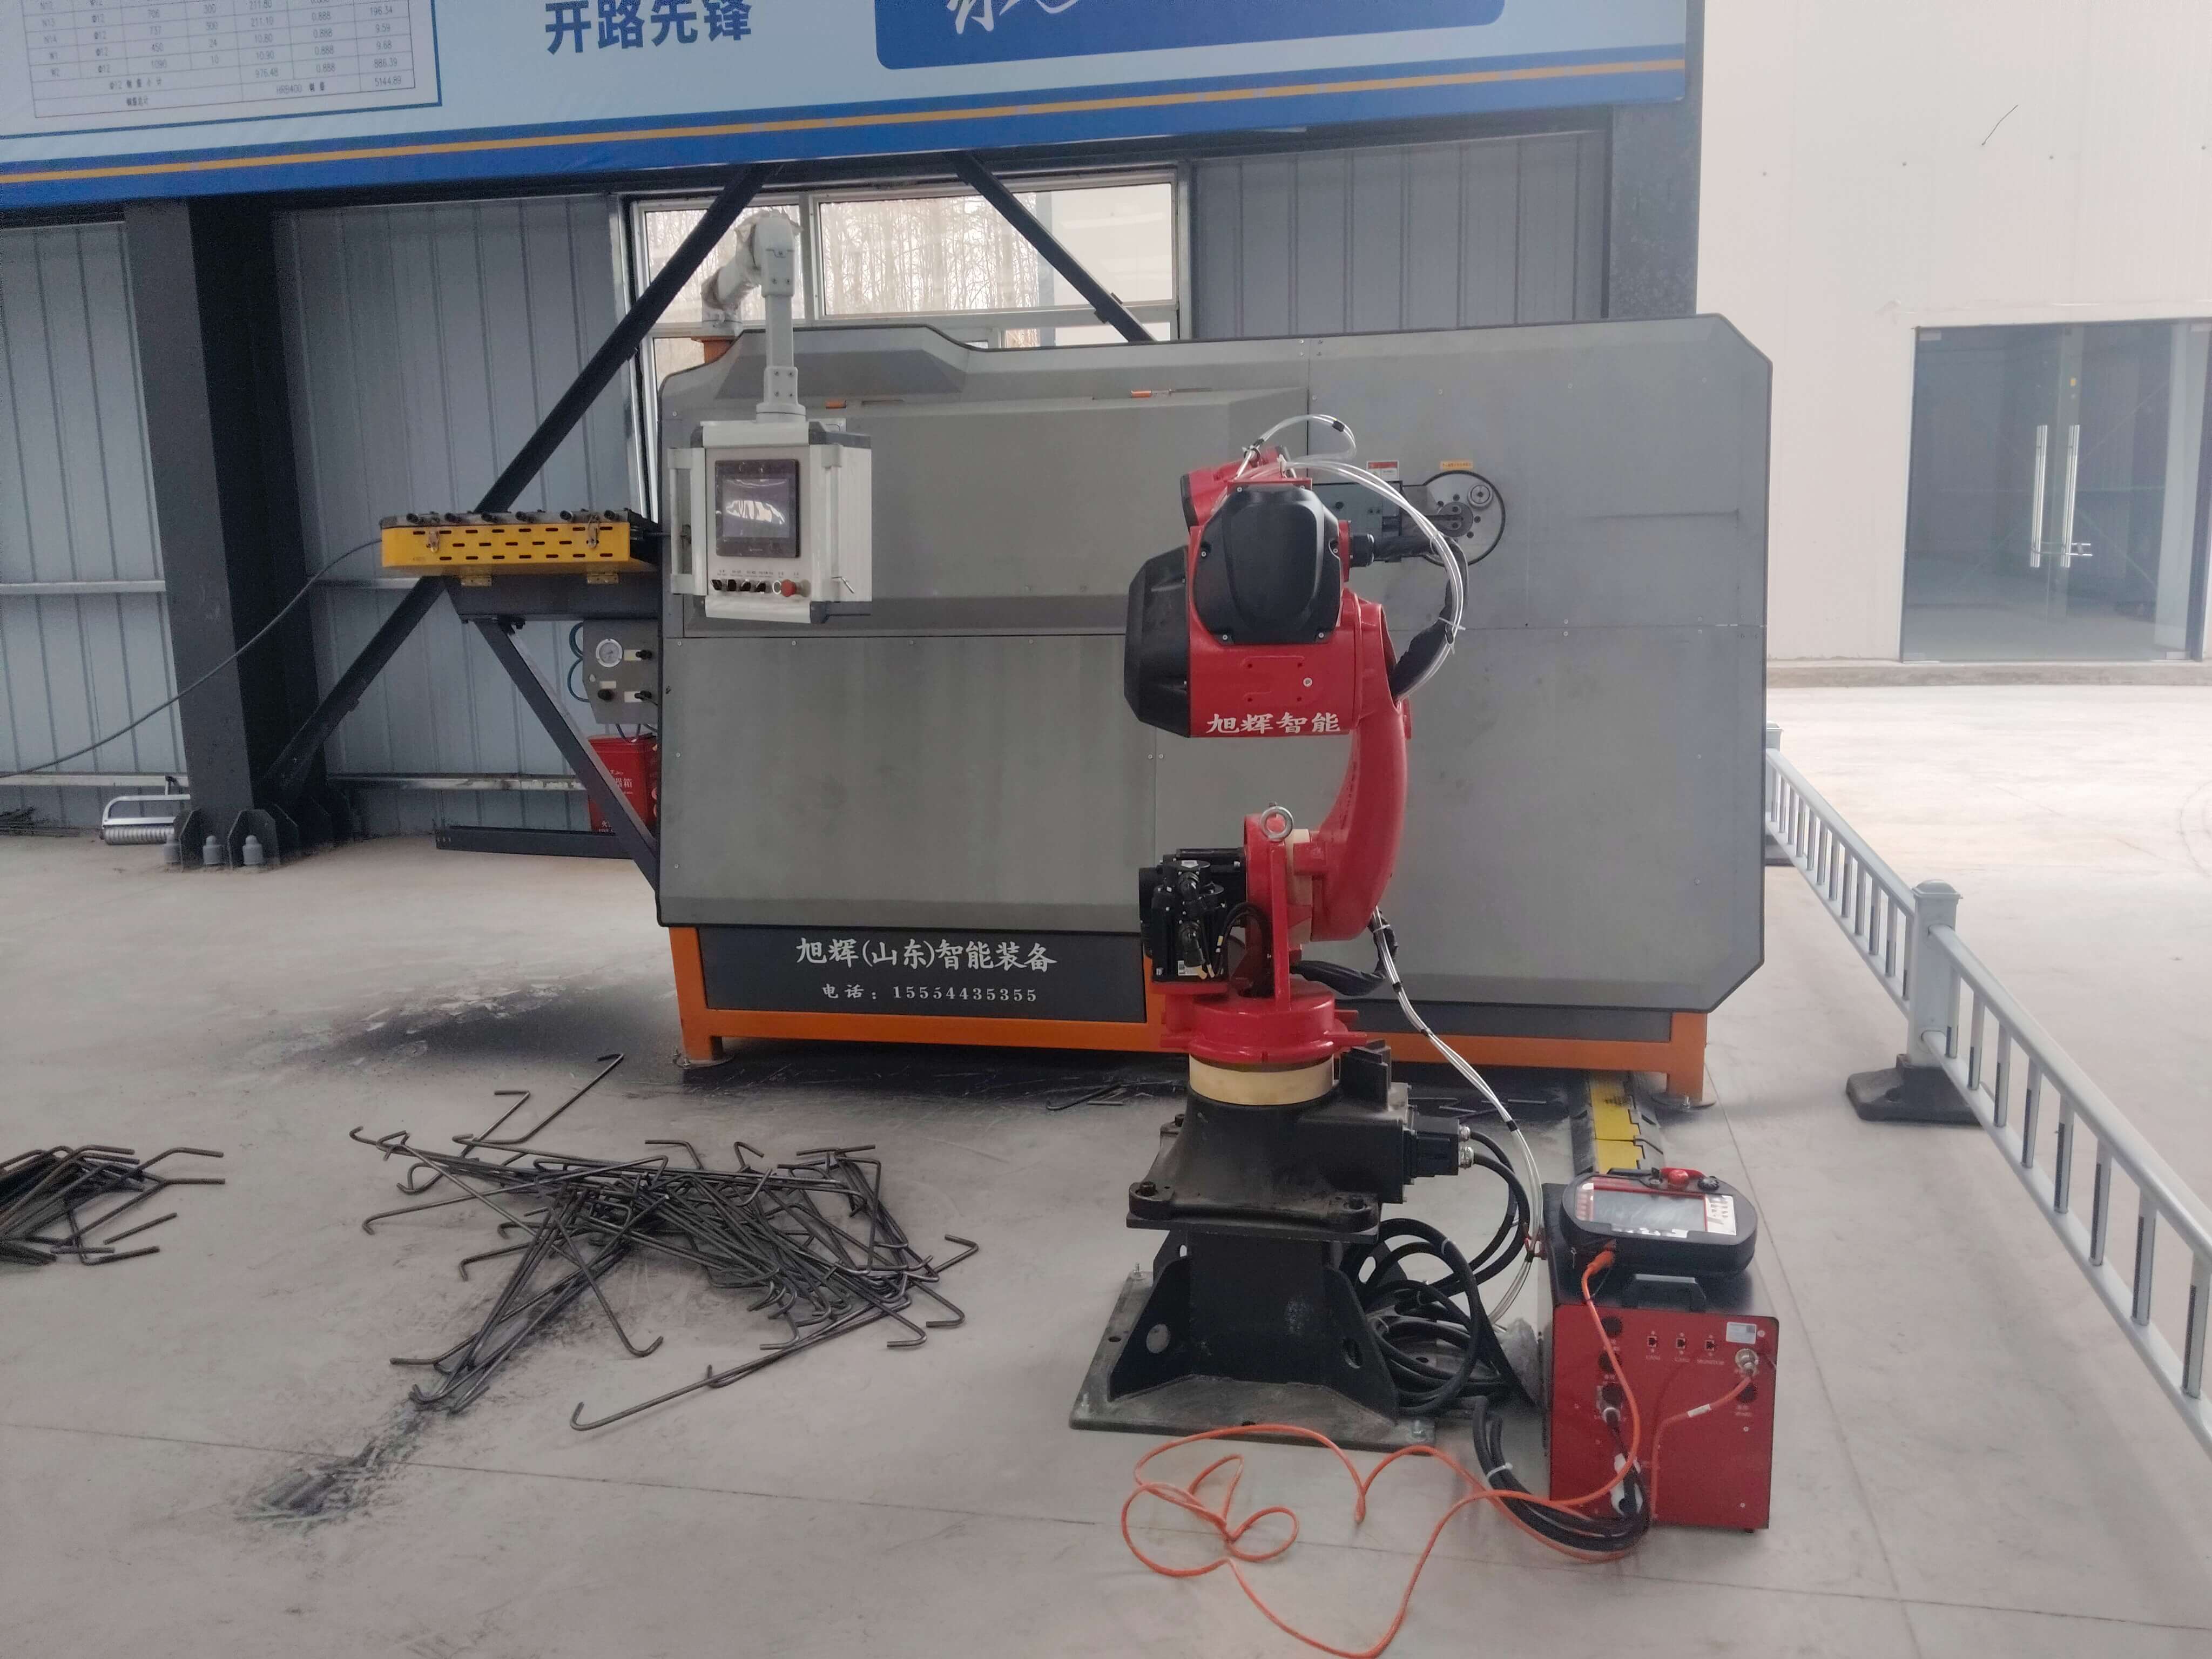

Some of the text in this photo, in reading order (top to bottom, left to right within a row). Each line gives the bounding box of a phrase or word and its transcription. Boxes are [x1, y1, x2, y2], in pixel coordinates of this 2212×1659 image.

[545, 0, 752, 54] 开路先锋
[376, 40, 392, 50] 9.68
[1206, 712, 1340, 734] 旭辉智能
[893, 986, 1036, 1002] 15554435355
